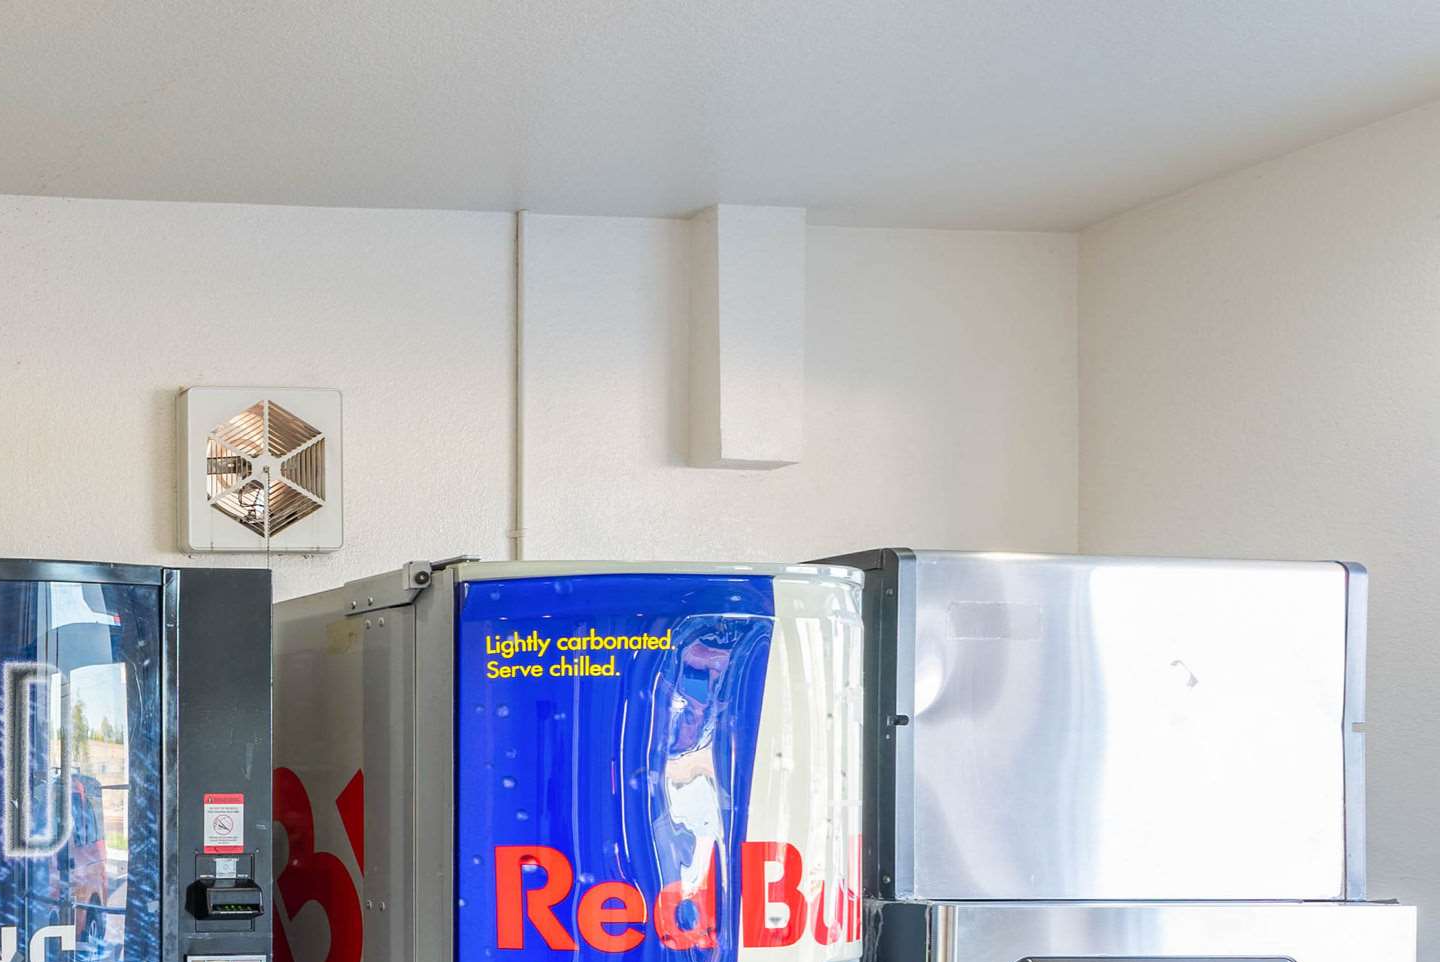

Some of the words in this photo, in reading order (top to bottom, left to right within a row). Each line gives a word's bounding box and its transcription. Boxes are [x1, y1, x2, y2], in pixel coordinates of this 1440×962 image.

[486, 631, 551, 658] Lightly
[557, 629, 676, 652] carbonated.
[486, 660, 543, 678] Serve
[549, 657, 620, 677] chilled.
[494, 840, 720, 952] Red
